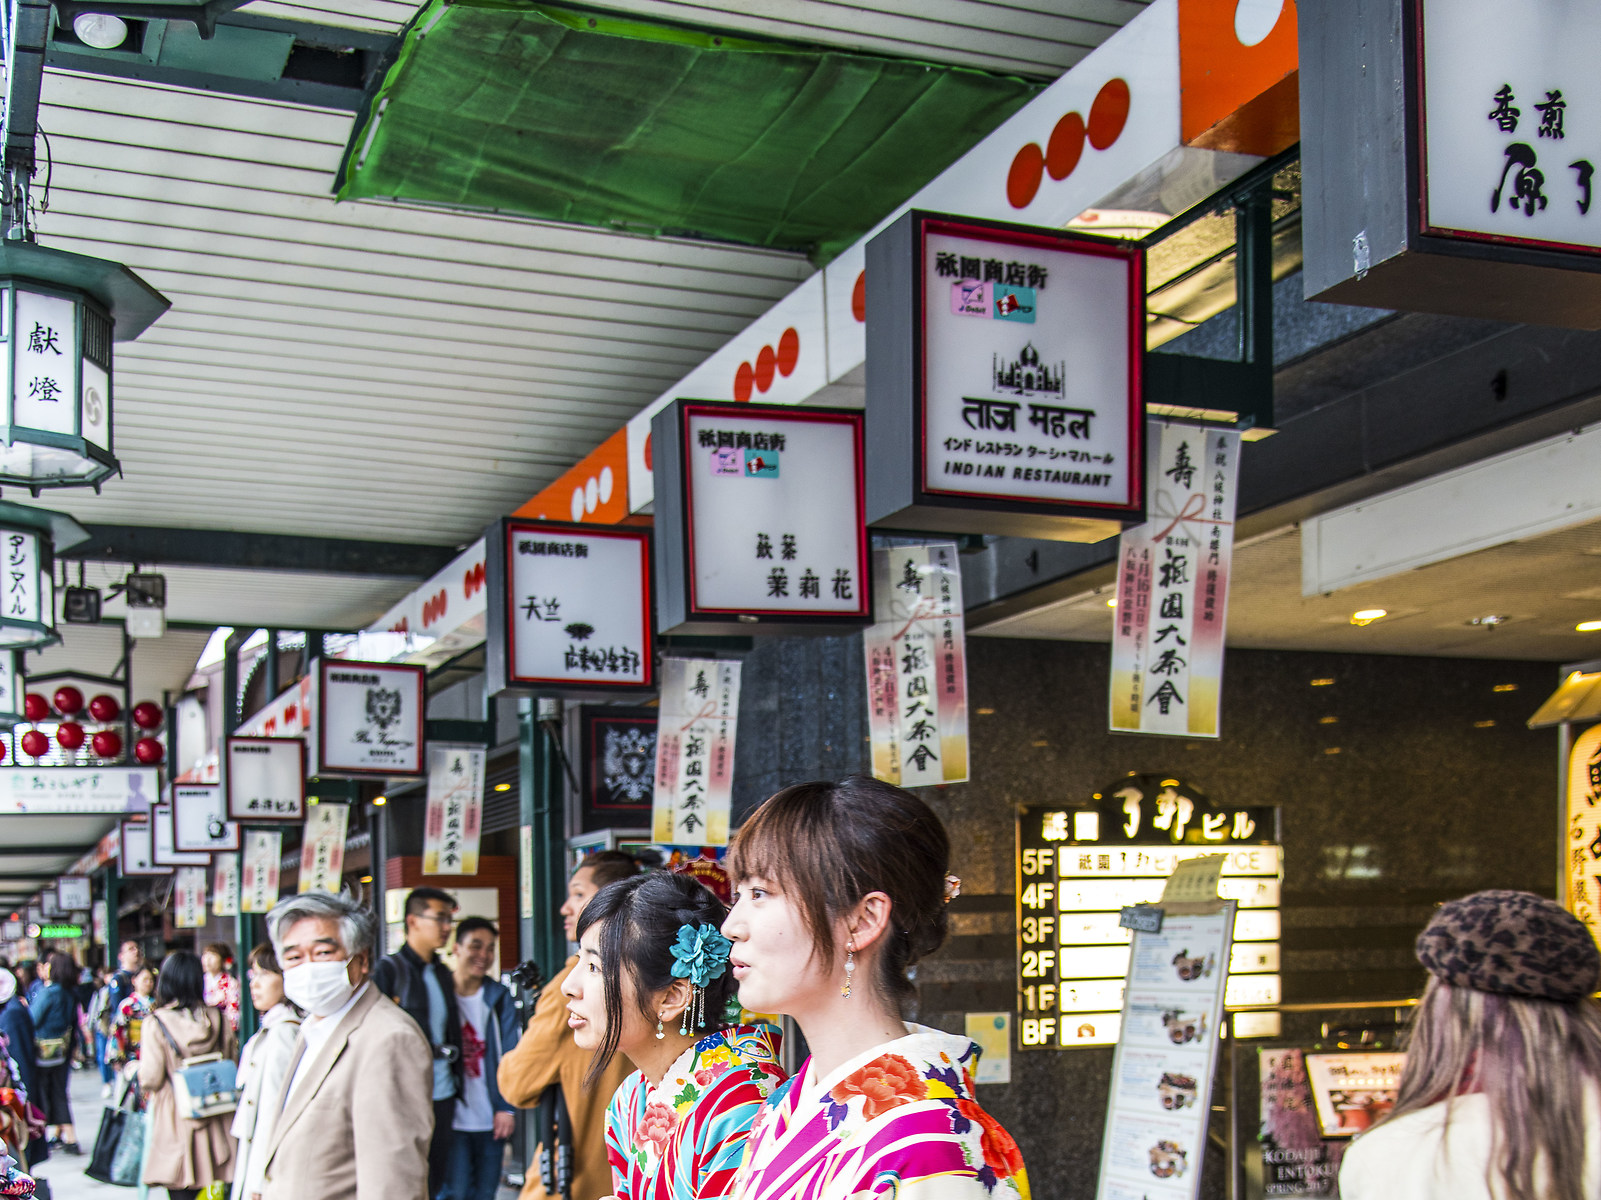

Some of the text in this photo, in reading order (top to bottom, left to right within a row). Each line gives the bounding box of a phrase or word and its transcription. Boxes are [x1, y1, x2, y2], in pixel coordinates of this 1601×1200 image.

[1488, 83, 1567, 139] 香煎
[962, 396, 1096, 439] ताज महल
[944, 437, 972, 452] インド
[976, 440, 1024, 456] レストラン
[944, 461, 1112, 488] INDIAN RESTAURANT
[756, 540, 798, 560] 飲茶
[767, 575, 853, 600] 茉莉花
[1022, 848, 1055, 876] 5F
[1021, 882, 1055, 909] 4F
[1022, 916, 1055, 944] 3F
[1022, 950, 1055, 978] 2F
[1023, 983, 1056, 1012] 1F
[1022, 1017, 1056, 1046] BF
